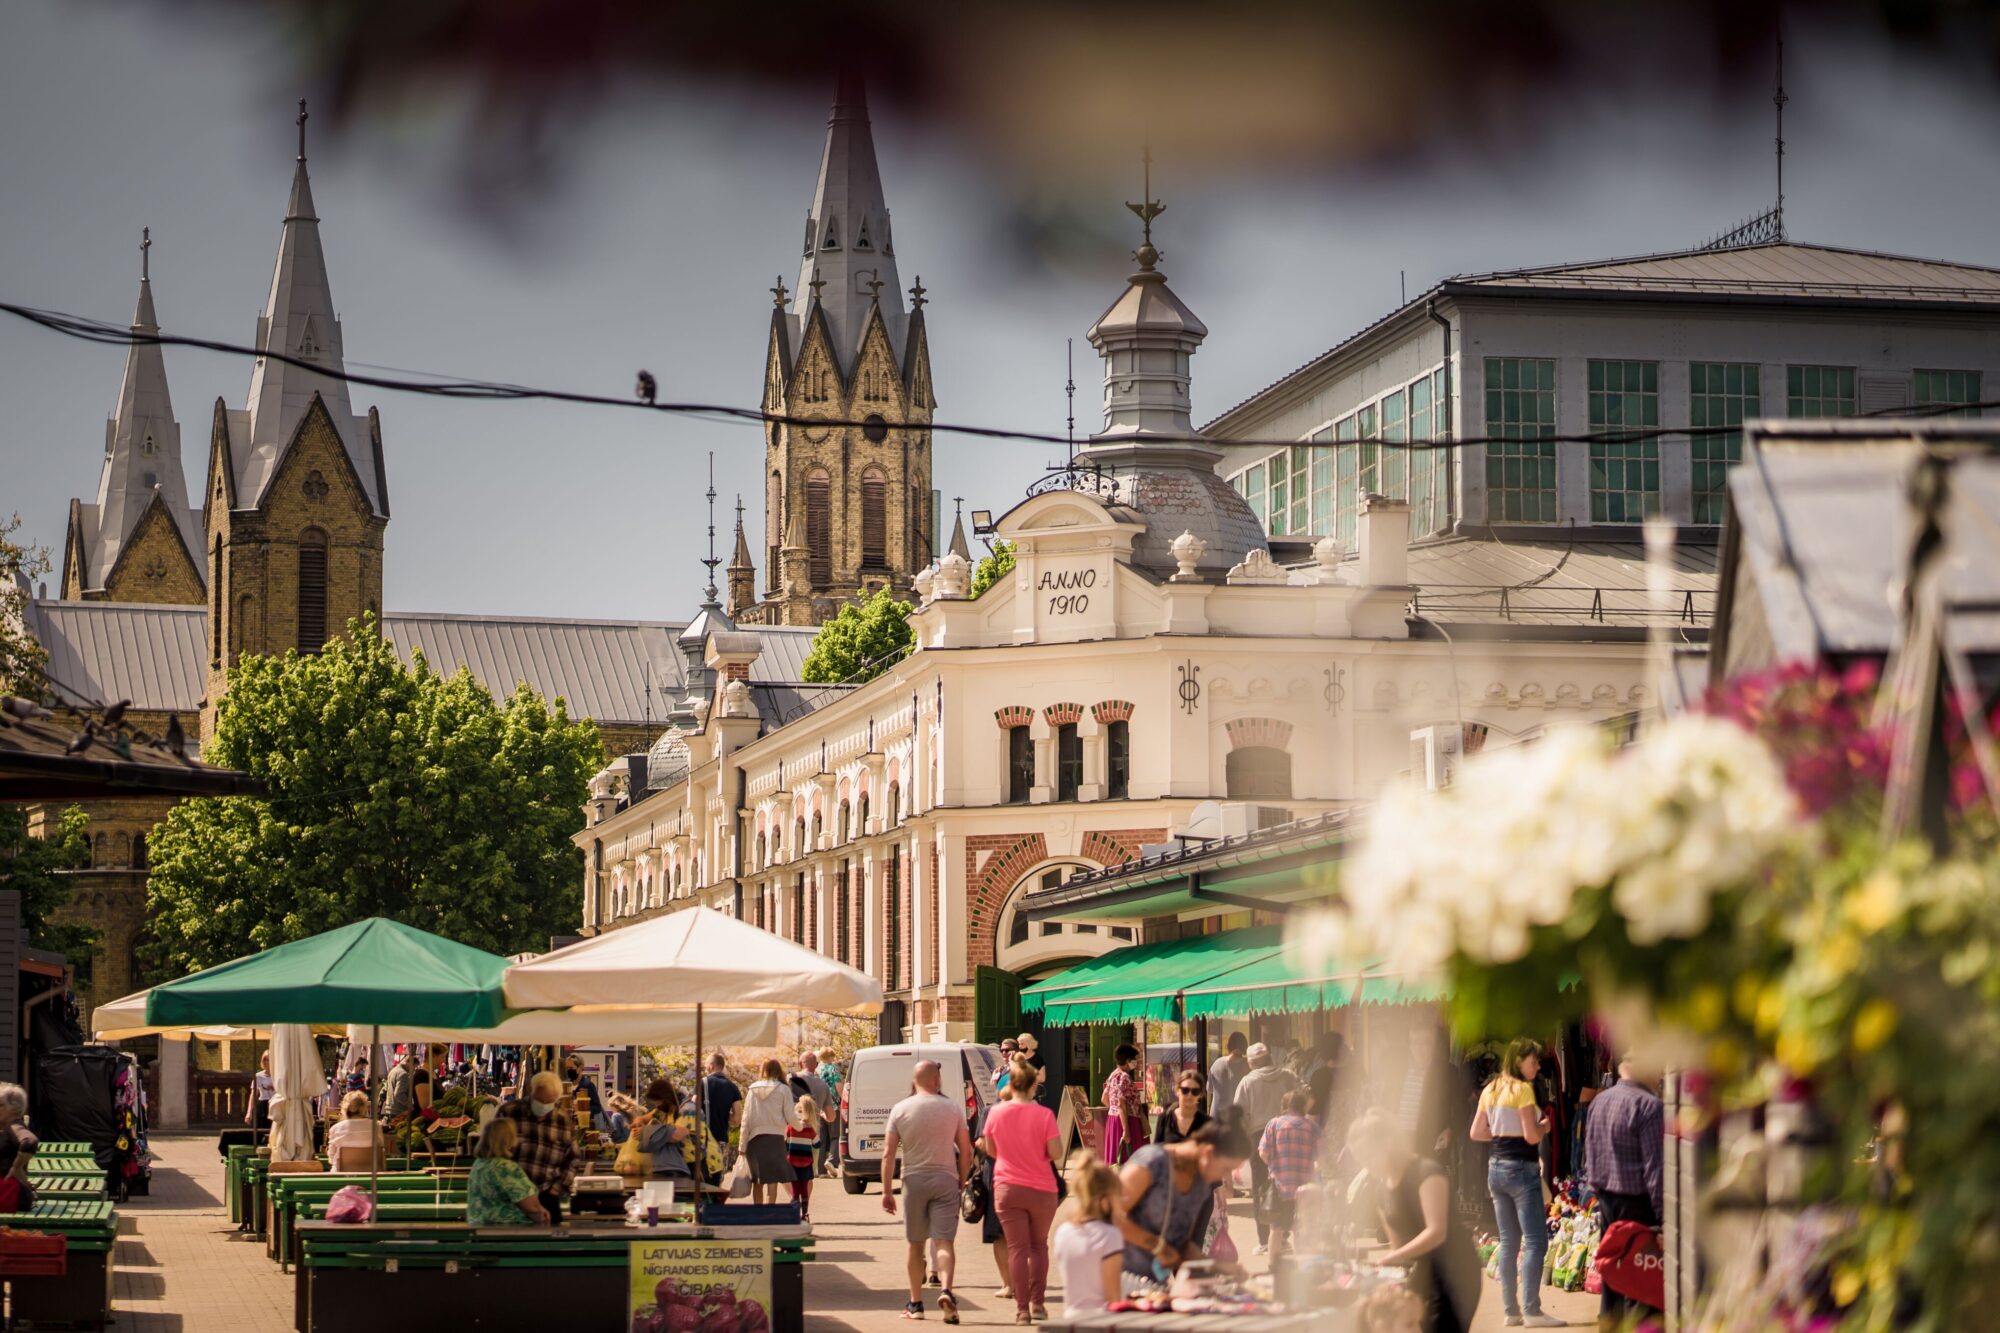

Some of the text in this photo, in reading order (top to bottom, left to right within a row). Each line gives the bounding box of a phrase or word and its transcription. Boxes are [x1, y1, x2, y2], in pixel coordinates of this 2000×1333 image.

[1037, 569, 1096, 591] ANNO
[1049, 594, 1089, 615] 1910
[643, 1247, 764, 1260] LATVIJAS ZEMENES
[643, 1262, 764, 1275] NĪGRANDES PAGASTS
